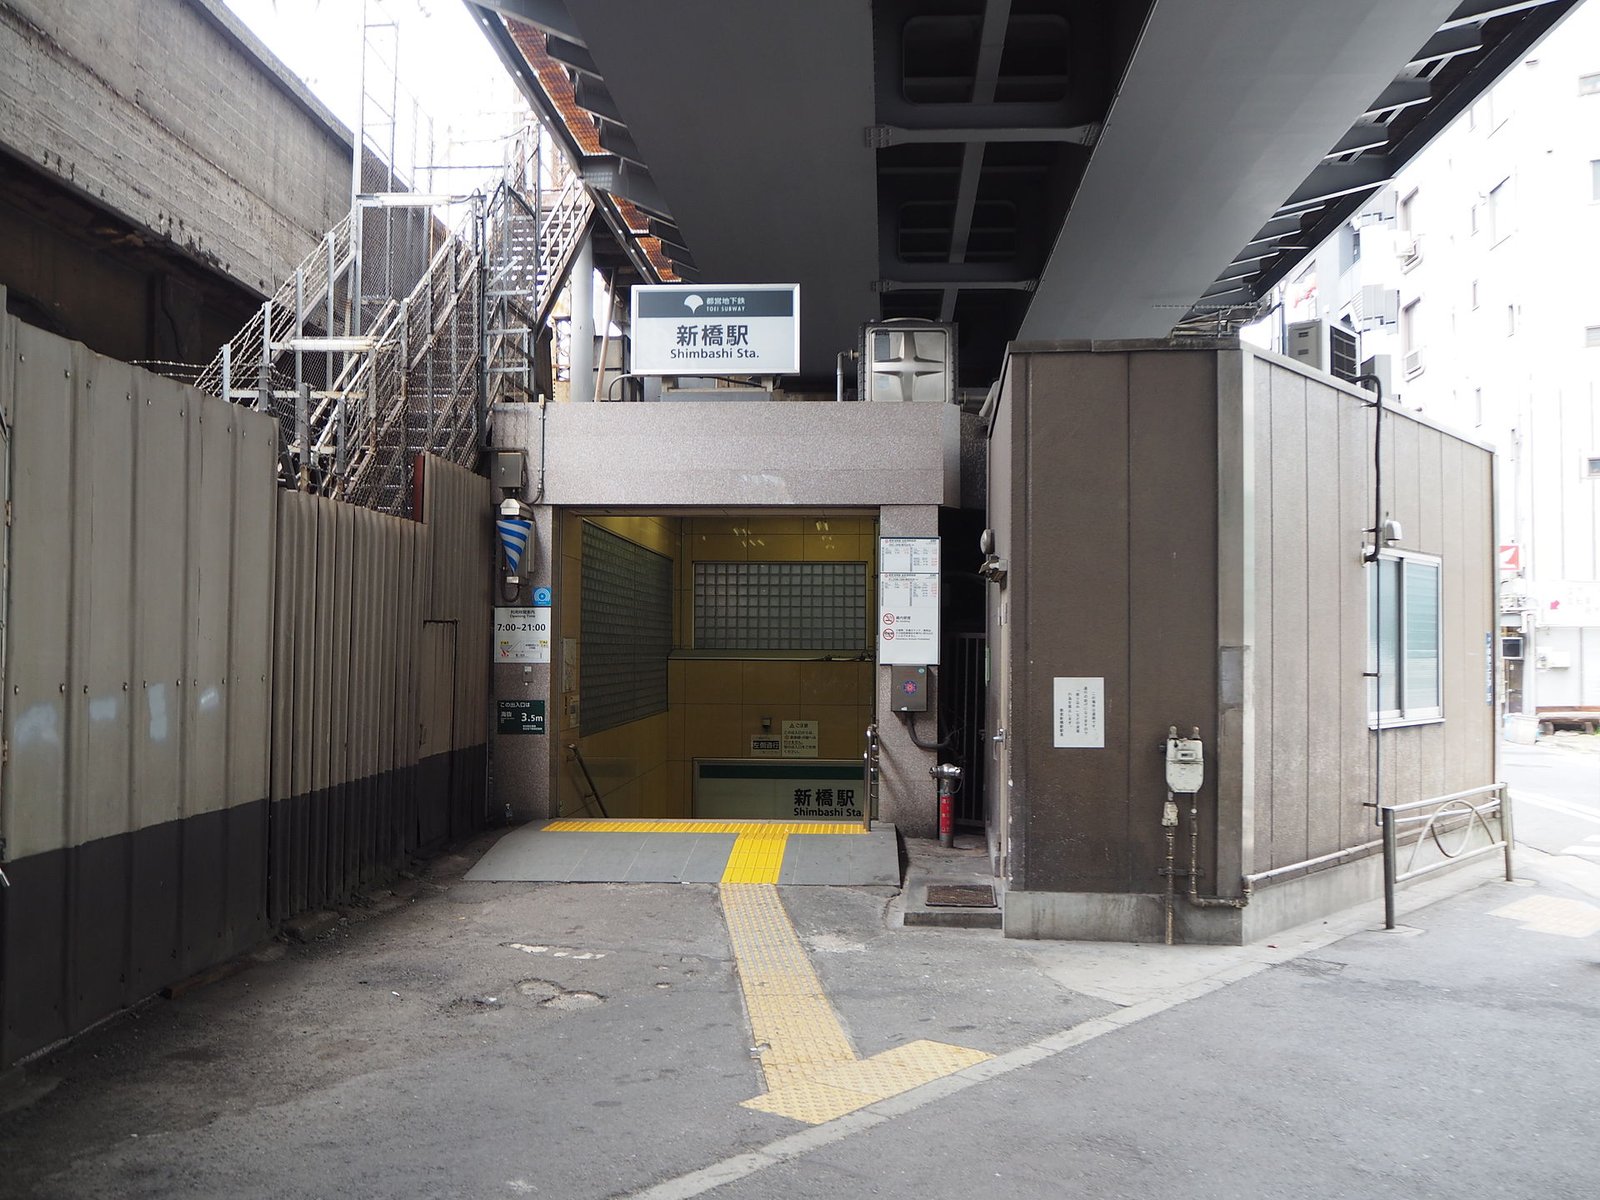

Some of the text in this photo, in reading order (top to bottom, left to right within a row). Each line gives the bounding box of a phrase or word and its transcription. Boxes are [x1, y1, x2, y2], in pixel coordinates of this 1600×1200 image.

[706, 297, 746, 306] 都営地下鉄
[676, 324, 749, 347] 新橋駅
[670, 348, 759, 360] Shimbashi Sta.
[521, 712, 543, 722] 3.5m
[794, 789, 854, 807] 新橋駅
[793, 807, 843, 817] Shimbashi
